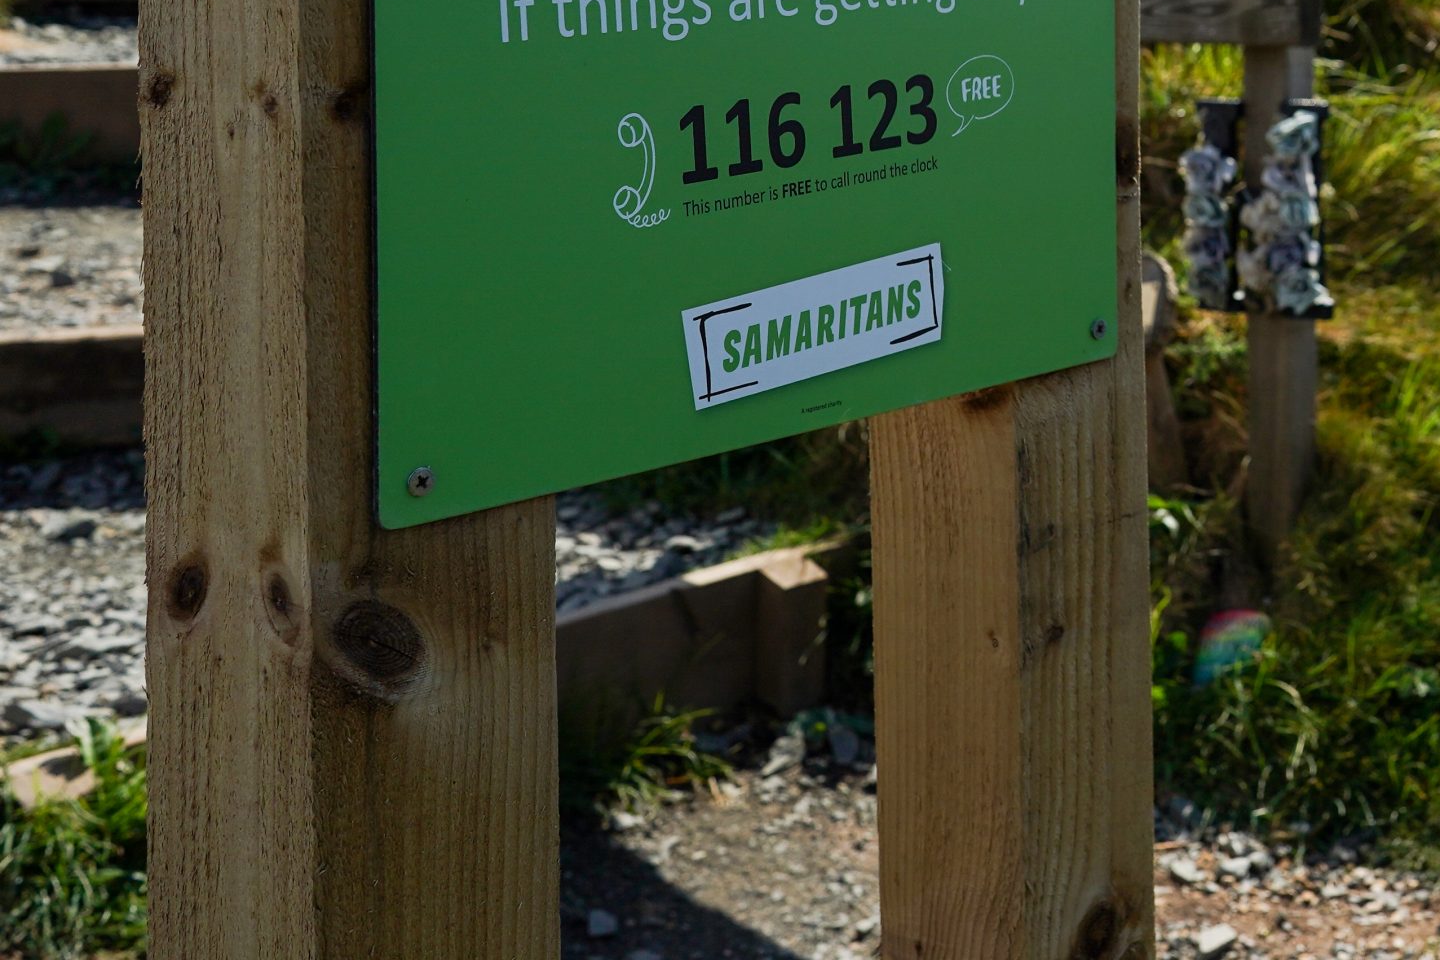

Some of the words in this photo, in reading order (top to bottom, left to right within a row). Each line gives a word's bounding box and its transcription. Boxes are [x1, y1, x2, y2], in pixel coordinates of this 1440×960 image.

[960, 74, 1002, 103] FREE
[679, 91, 806, 185] 116
[829, 73, 939, 159] 123
[683, 198, 711, 217] This
[714, 190, 766, 212] number
[768, 186, 779, 201] is
[782, 179, 812, 198] FREE
[815, 178, 828, 192] to
[831, 171, 850, 189] call
[853, 164, 887, 185] round
[889, 162, 908, 178] the
[911, 155, 938, 174] clock
[722, 279, 922, 373] SAMARITANS
